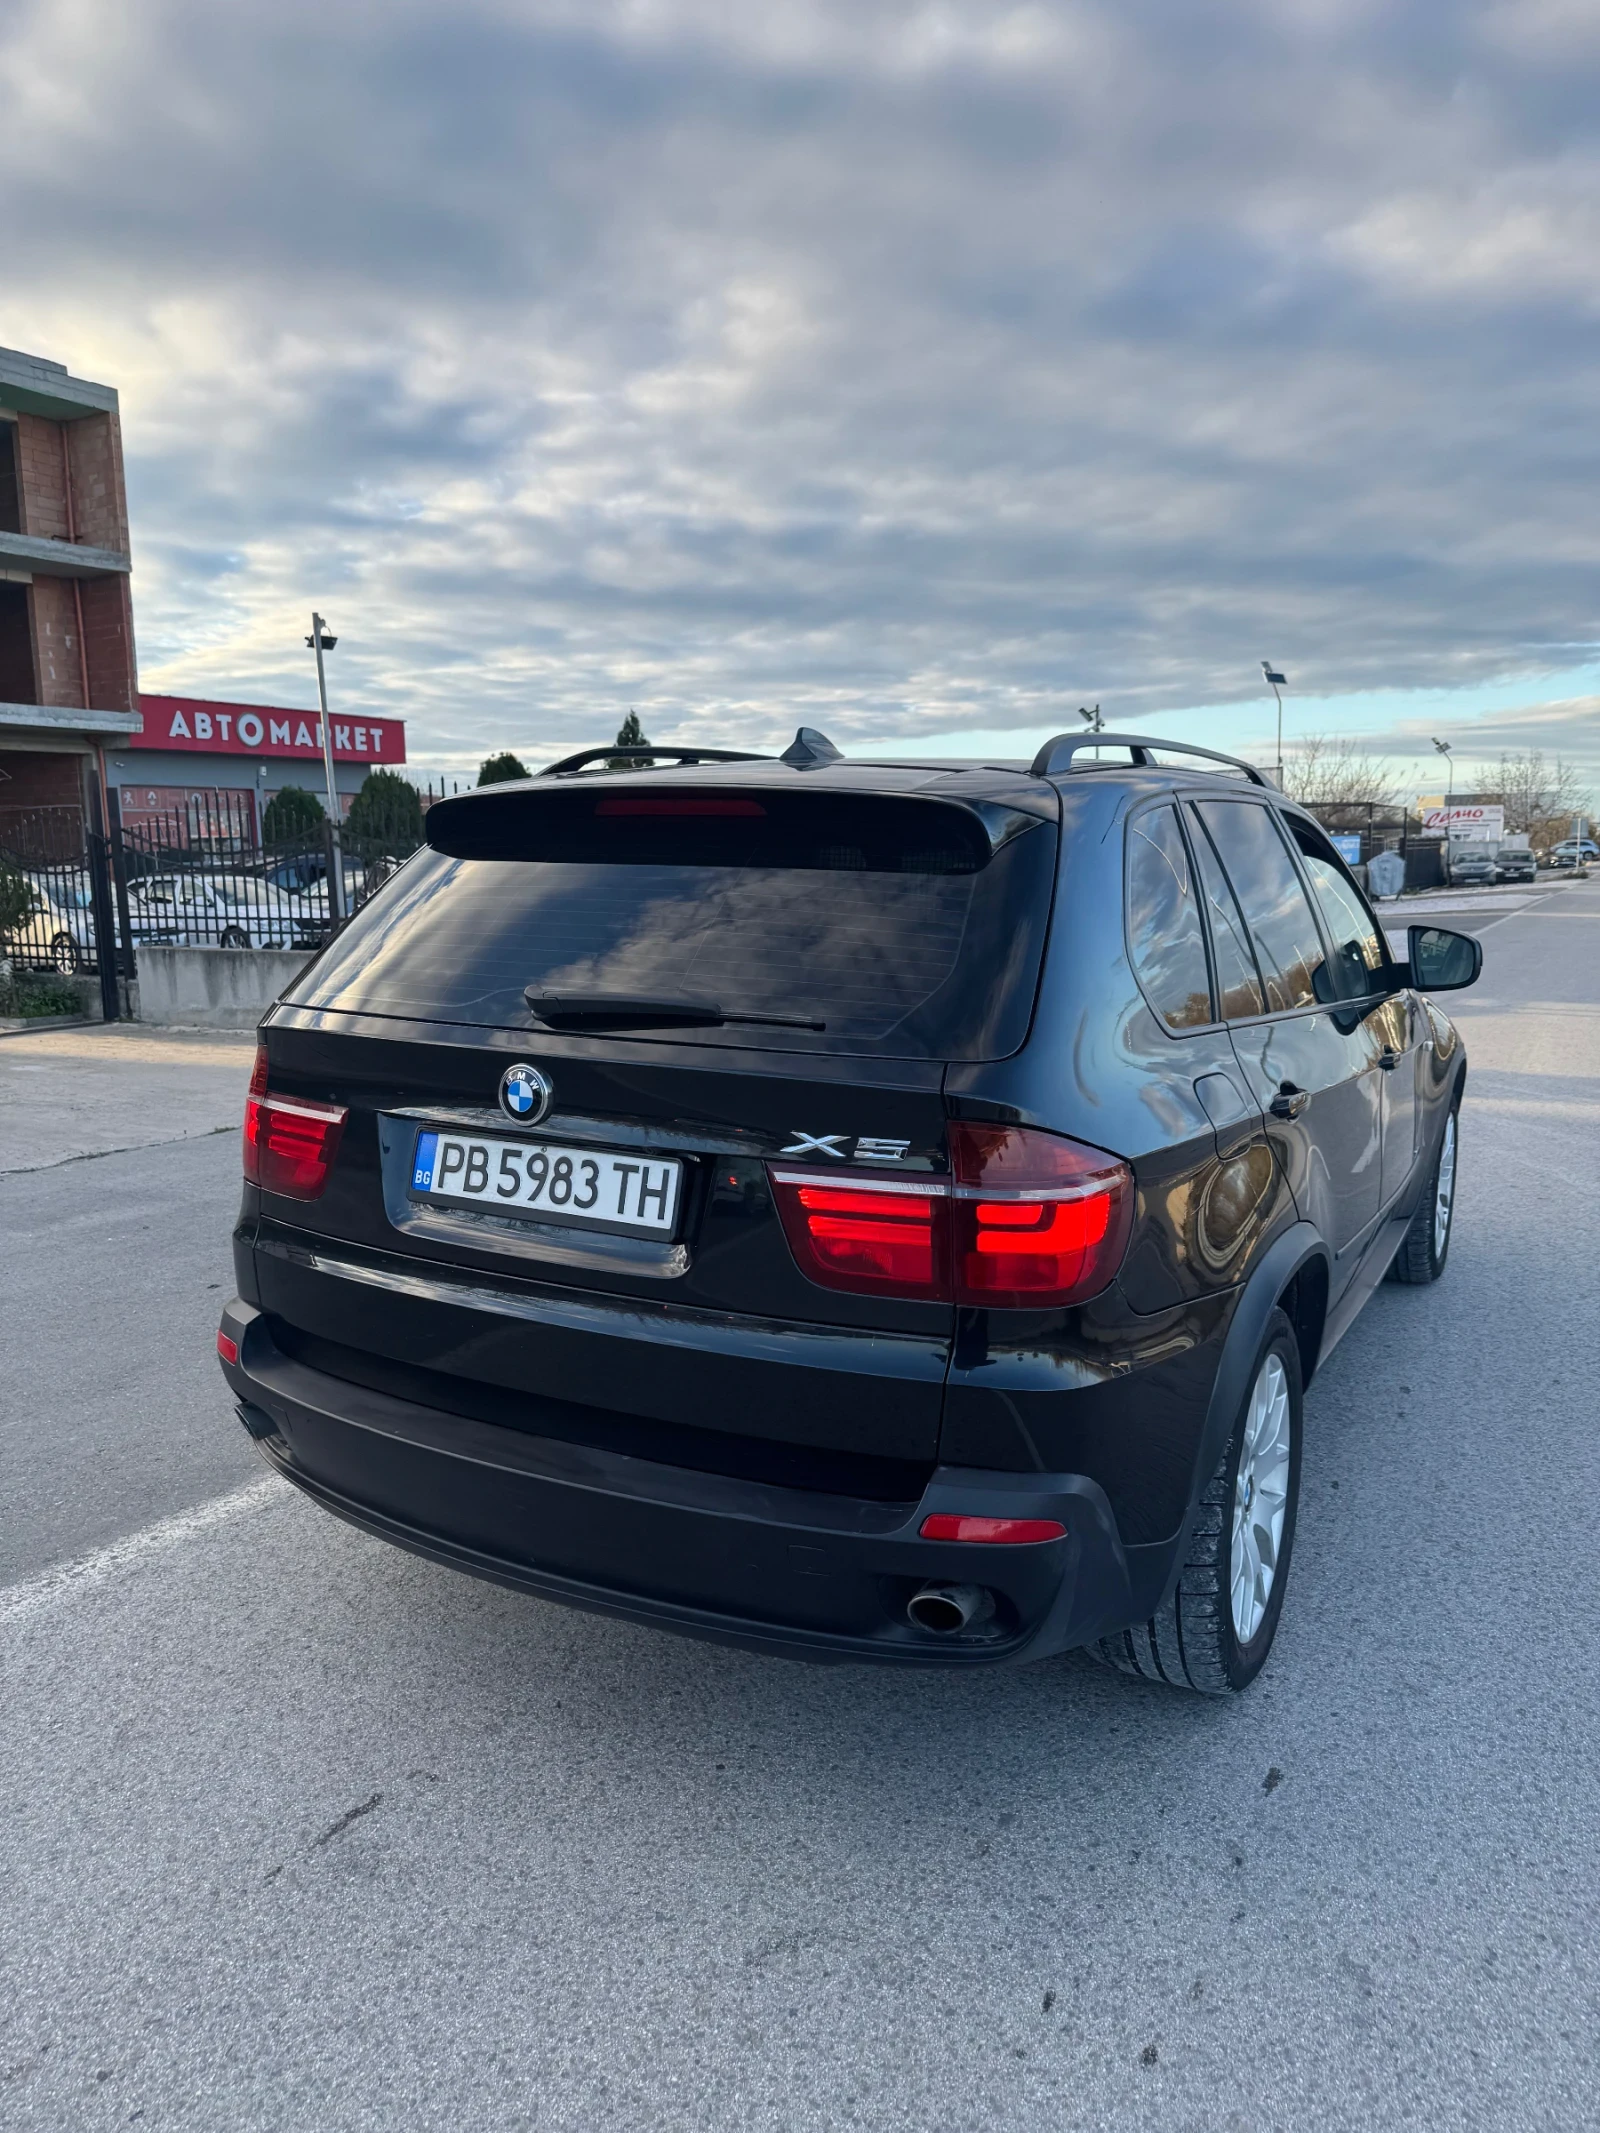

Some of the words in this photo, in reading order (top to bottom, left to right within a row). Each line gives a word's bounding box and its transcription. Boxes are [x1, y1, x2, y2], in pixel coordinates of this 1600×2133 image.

[169, 710, 383, 752] АВТОМАРКЕТ
[506, 1071, 540, 1090] BMW
[780, 1130, 911, 1161] X5
[414, 1169, 431, 1185] BG
[437, 1142, 489, 1193] PB
[497, 1149, 599, 1209] 5983
[613, 1162, 670, 1220] TH
